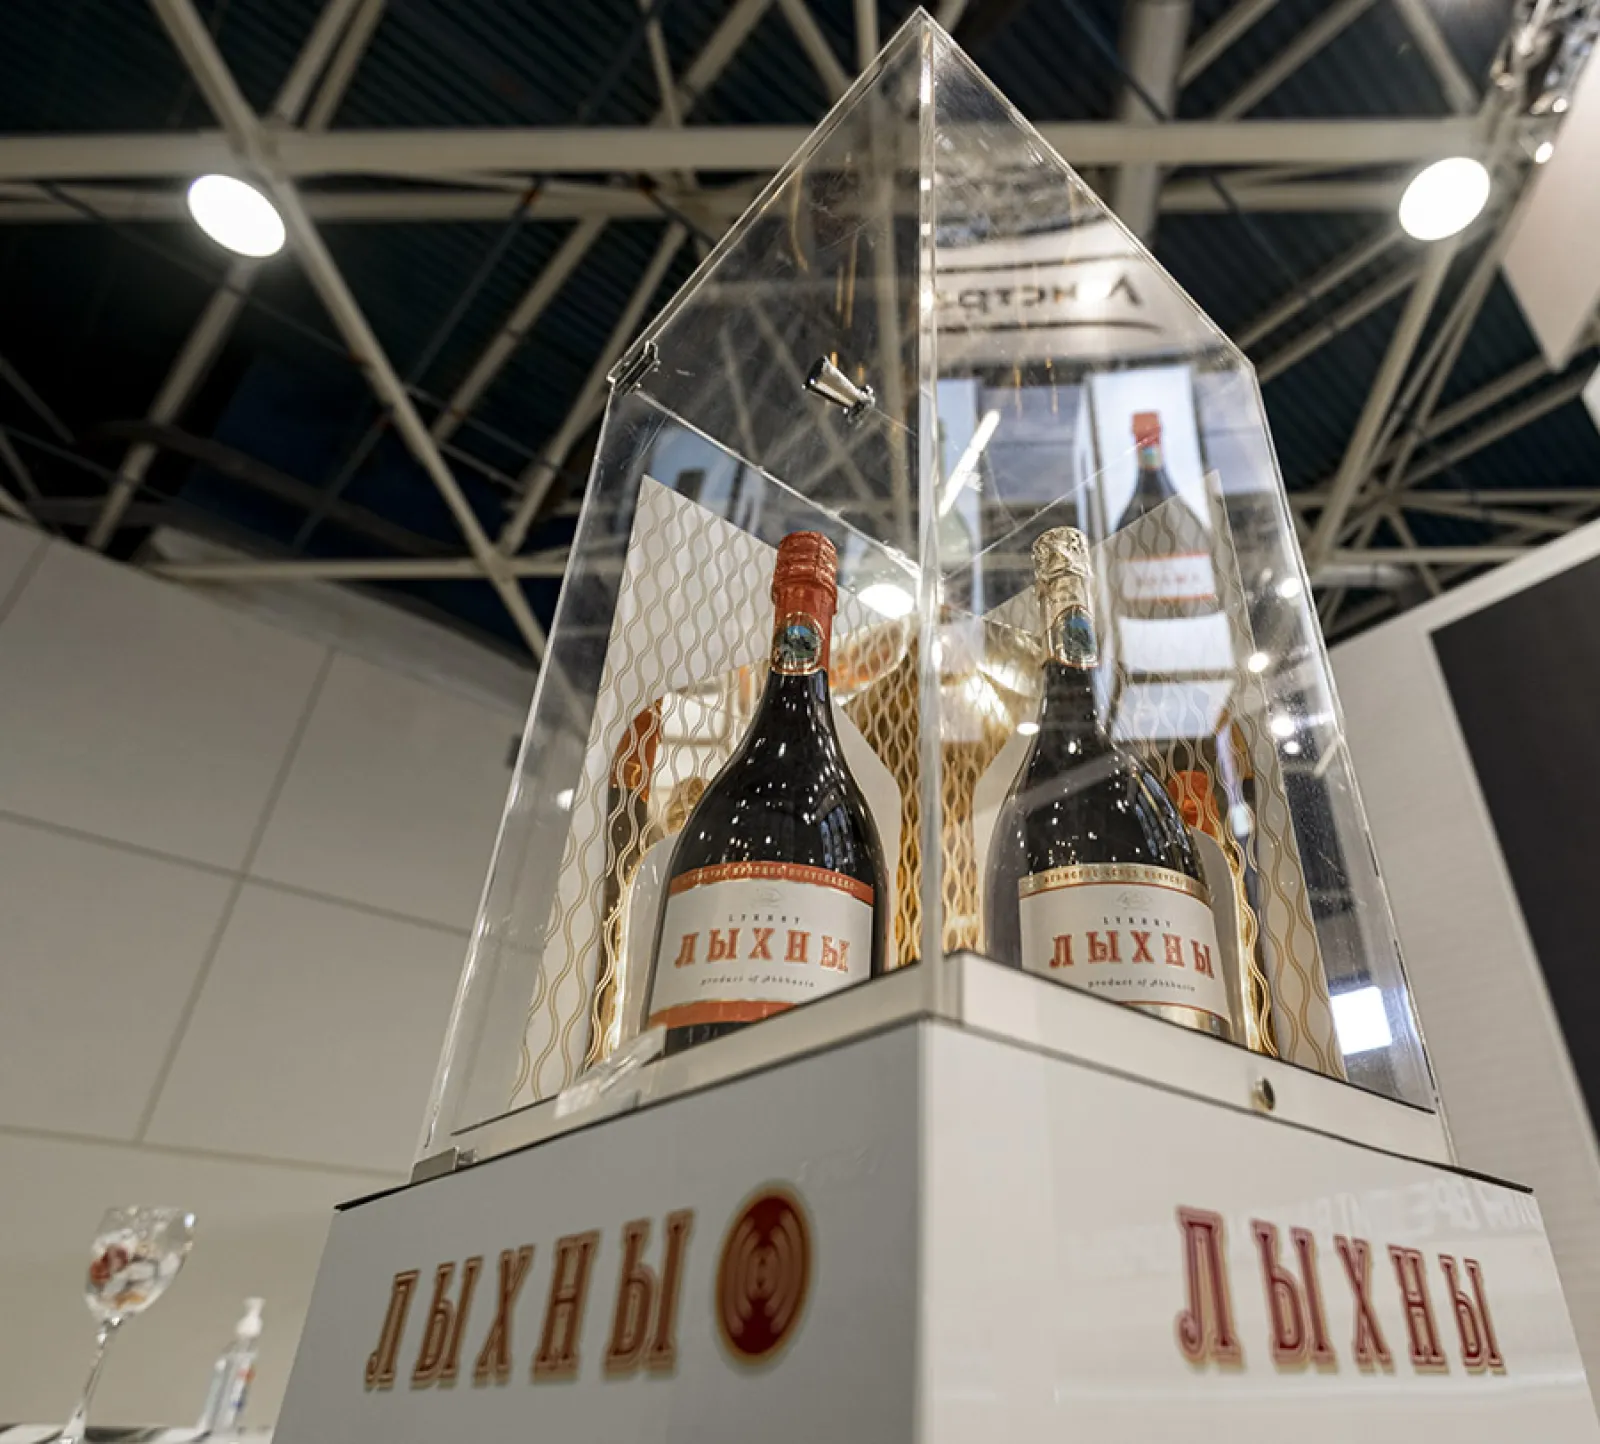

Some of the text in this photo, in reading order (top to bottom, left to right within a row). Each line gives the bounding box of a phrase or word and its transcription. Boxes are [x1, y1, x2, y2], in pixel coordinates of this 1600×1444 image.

[674, 928, 850, 973] ЛЫХНЫ
[1049, 930, 1215, 980] ЛЫХНЫ
[364, 1207, 695, 1391] ЛЫХНЫ
[1176, 1205, 1507, 1375] ЛЫХНЫ
